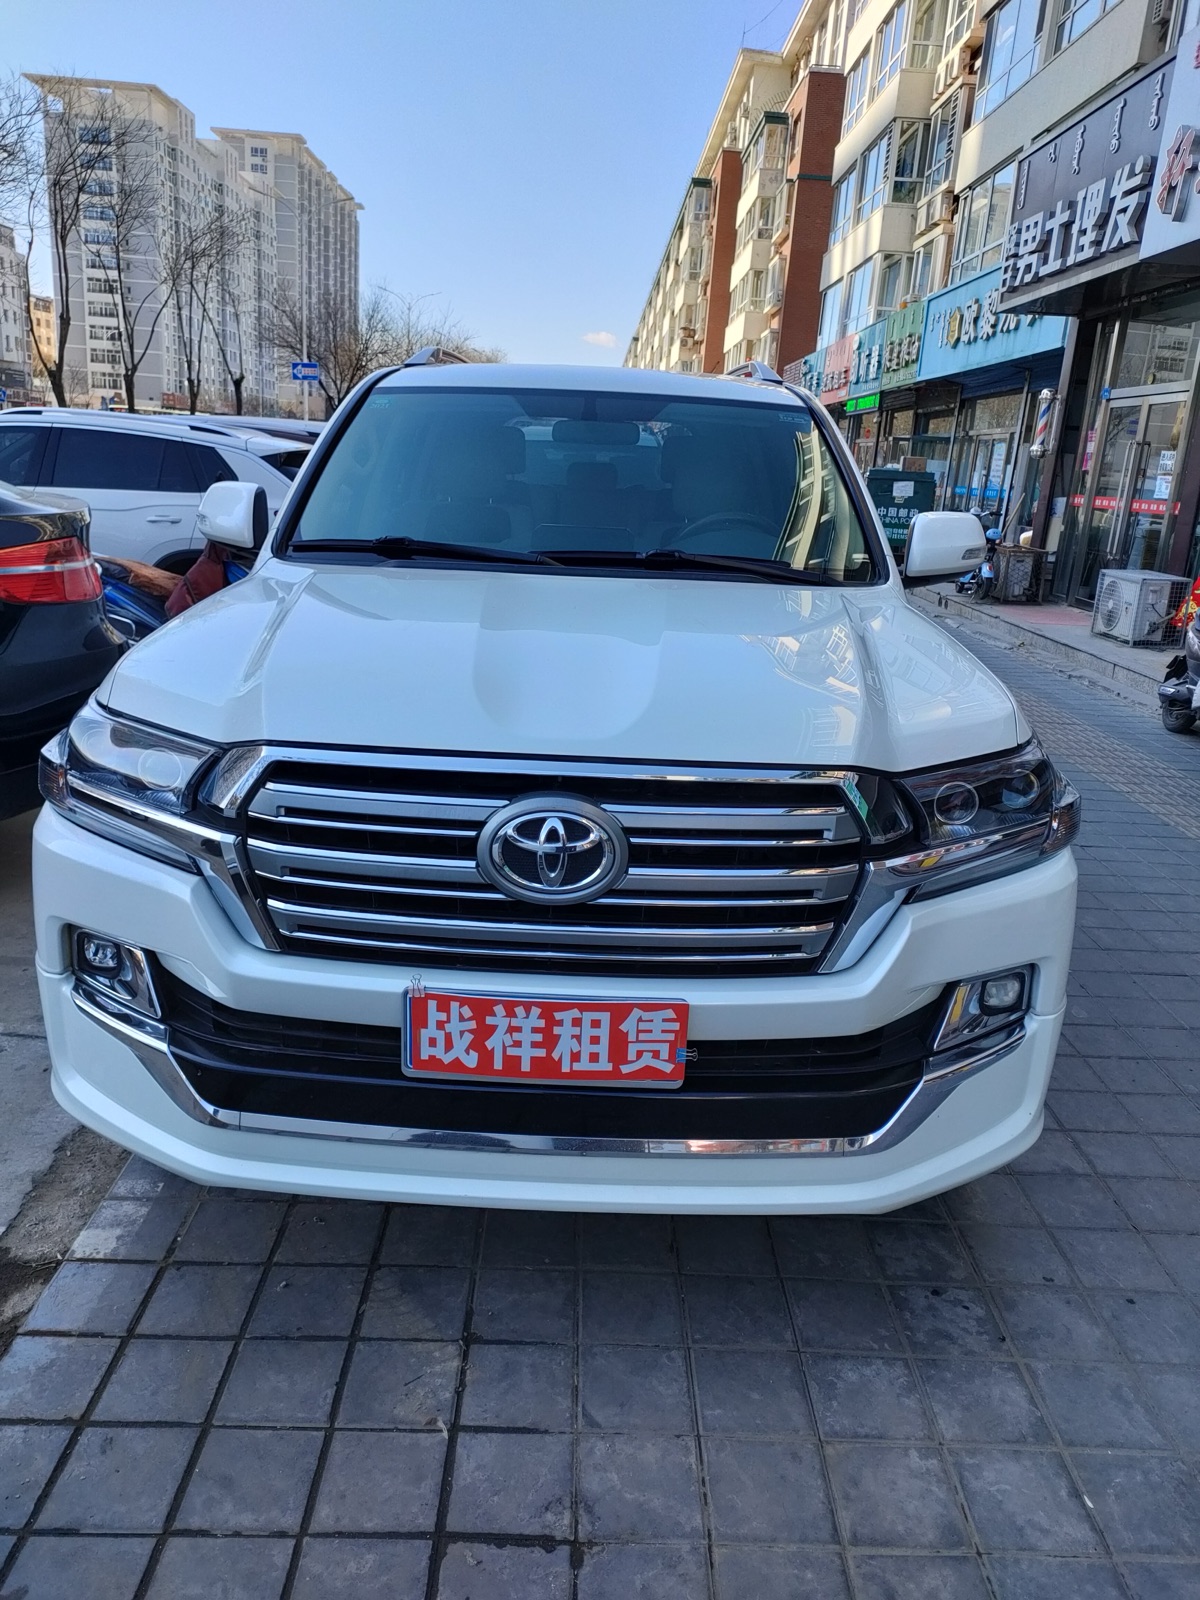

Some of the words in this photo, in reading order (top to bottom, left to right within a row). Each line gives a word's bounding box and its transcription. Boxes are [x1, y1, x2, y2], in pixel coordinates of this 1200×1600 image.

[877, 506, 919, 518] 中国邮政
[419, 1000, 681, 1075] 战祥租赁
